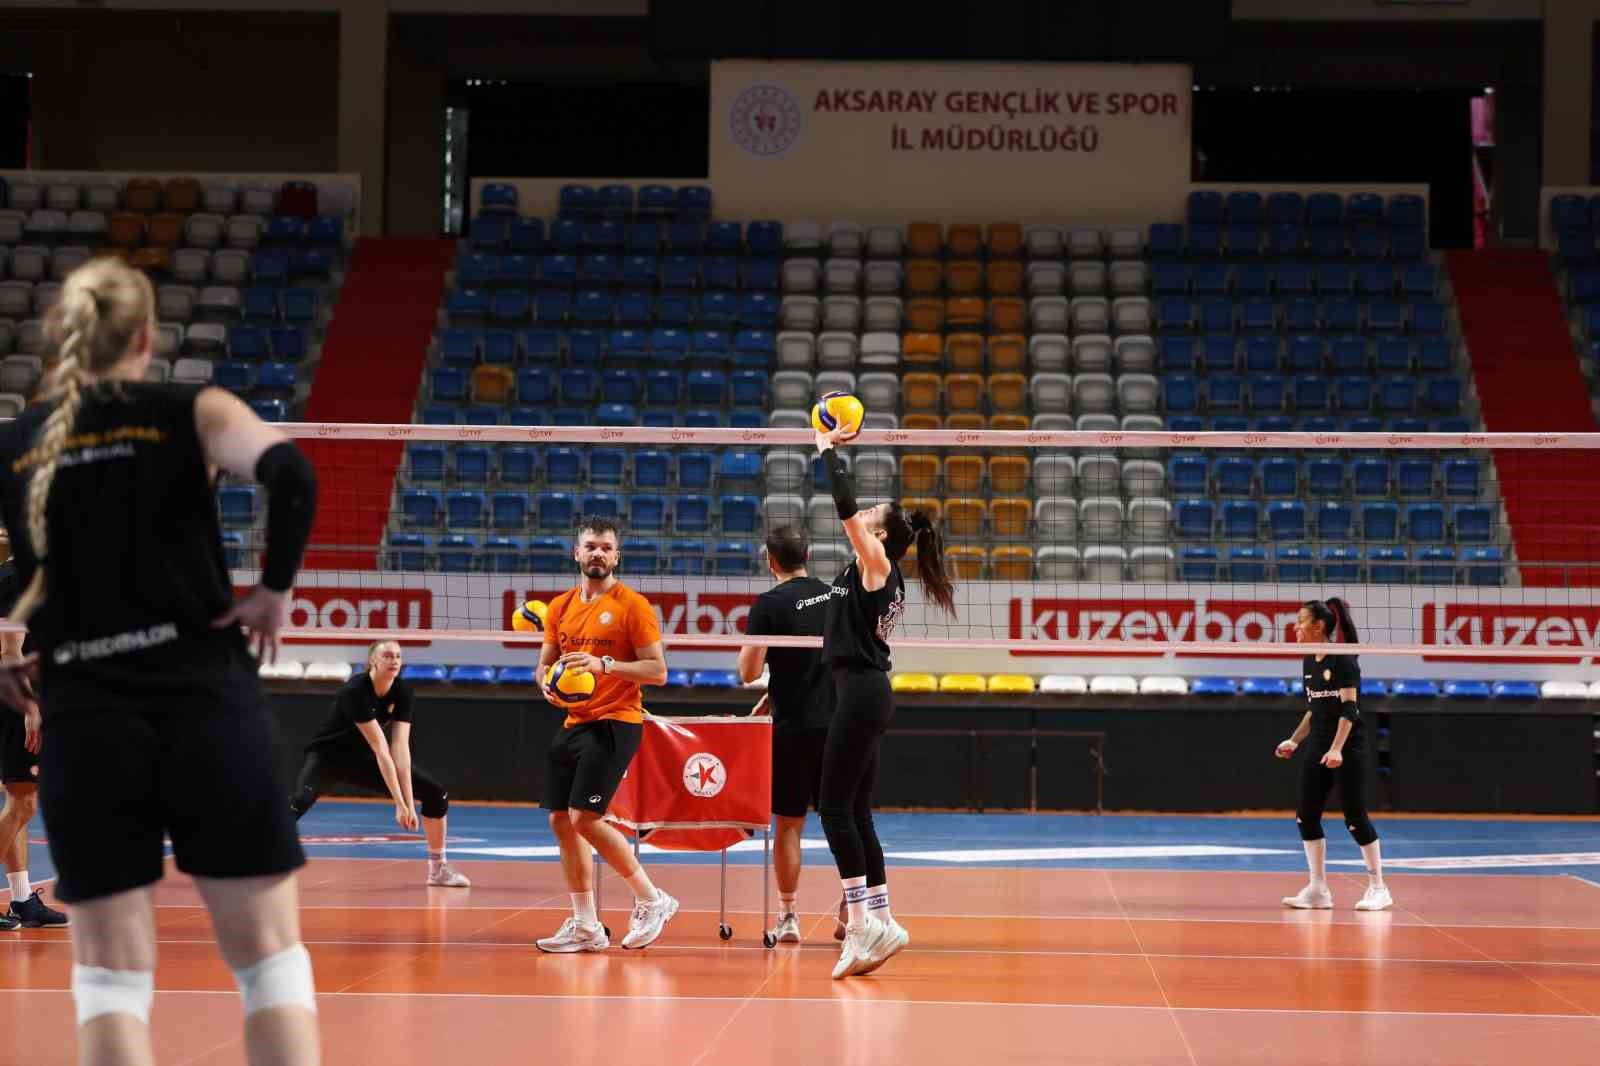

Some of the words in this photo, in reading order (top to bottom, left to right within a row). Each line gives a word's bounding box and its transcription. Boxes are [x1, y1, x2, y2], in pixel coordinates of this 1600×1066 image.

[814, 90, 937, 112] AKSARAY
[945, 88, 1060, 118] GENÇLİK
[1066, 92, 1099, 113] VE
[1106, 92, 1177, 115] SPOR
[891, 123, 913, 150] İL
[921, 125, 1098, 152] MÜDÜRLÜĞÜ
[1021, 599, 1309, 658] kuzeybor
